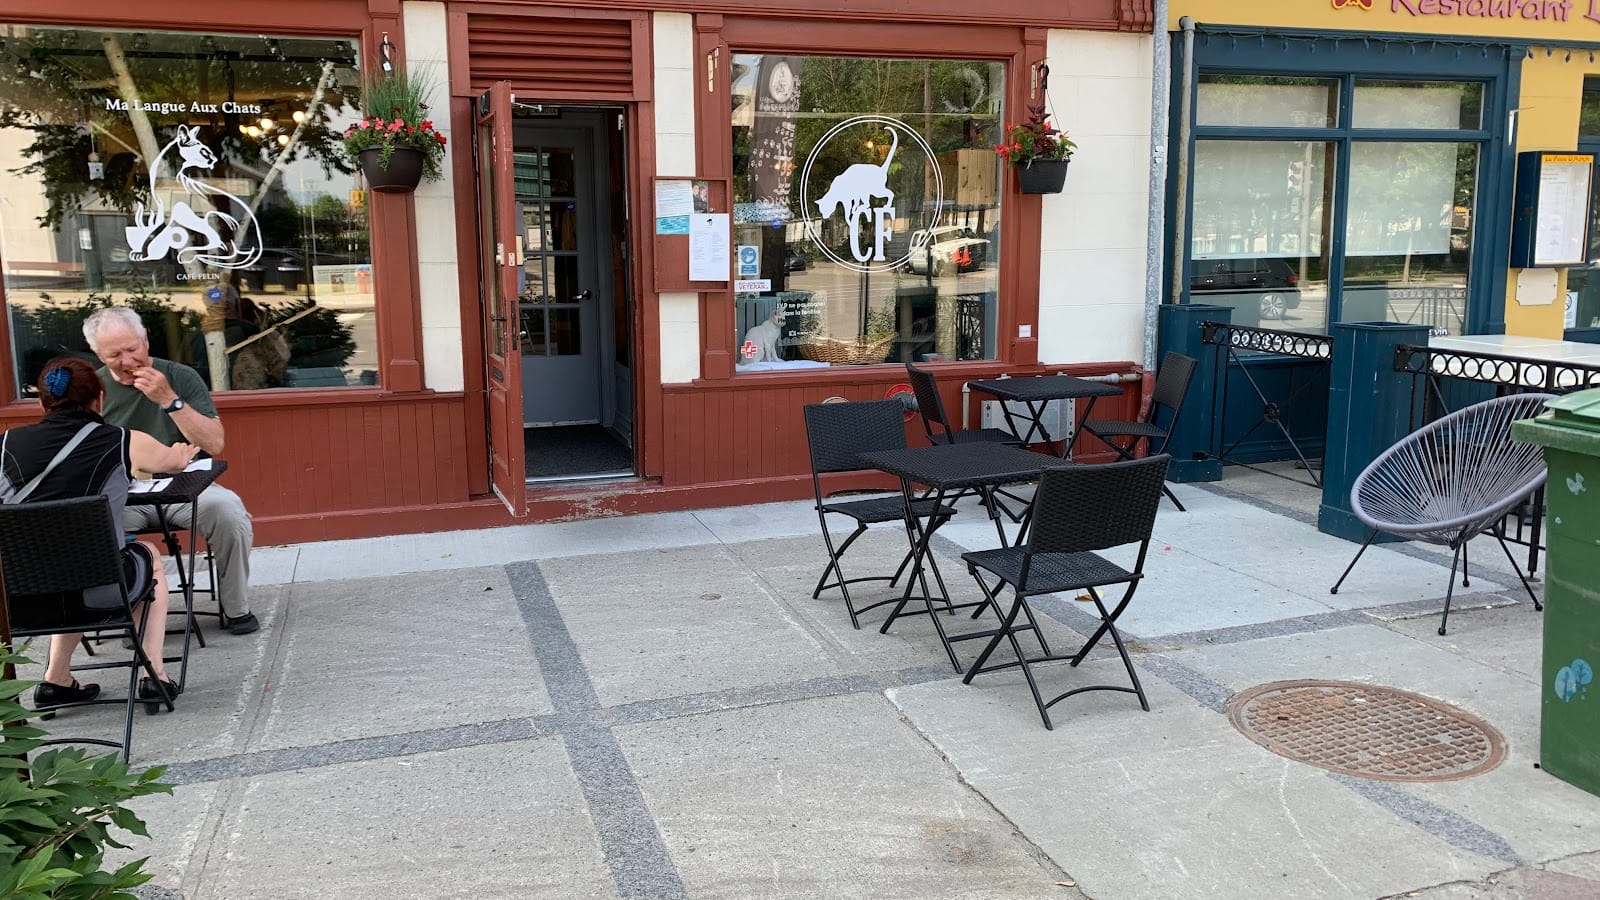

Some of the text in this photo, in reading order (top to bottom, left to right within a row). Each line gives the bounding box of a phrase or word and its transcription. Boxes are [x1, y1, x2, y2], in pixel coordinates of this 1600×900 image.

[1391, 0, 1573, 21] Restaurant
[105, 98, 261, 114] Ma Langue Aux Chats
[850, 204, 896, 262] CF
